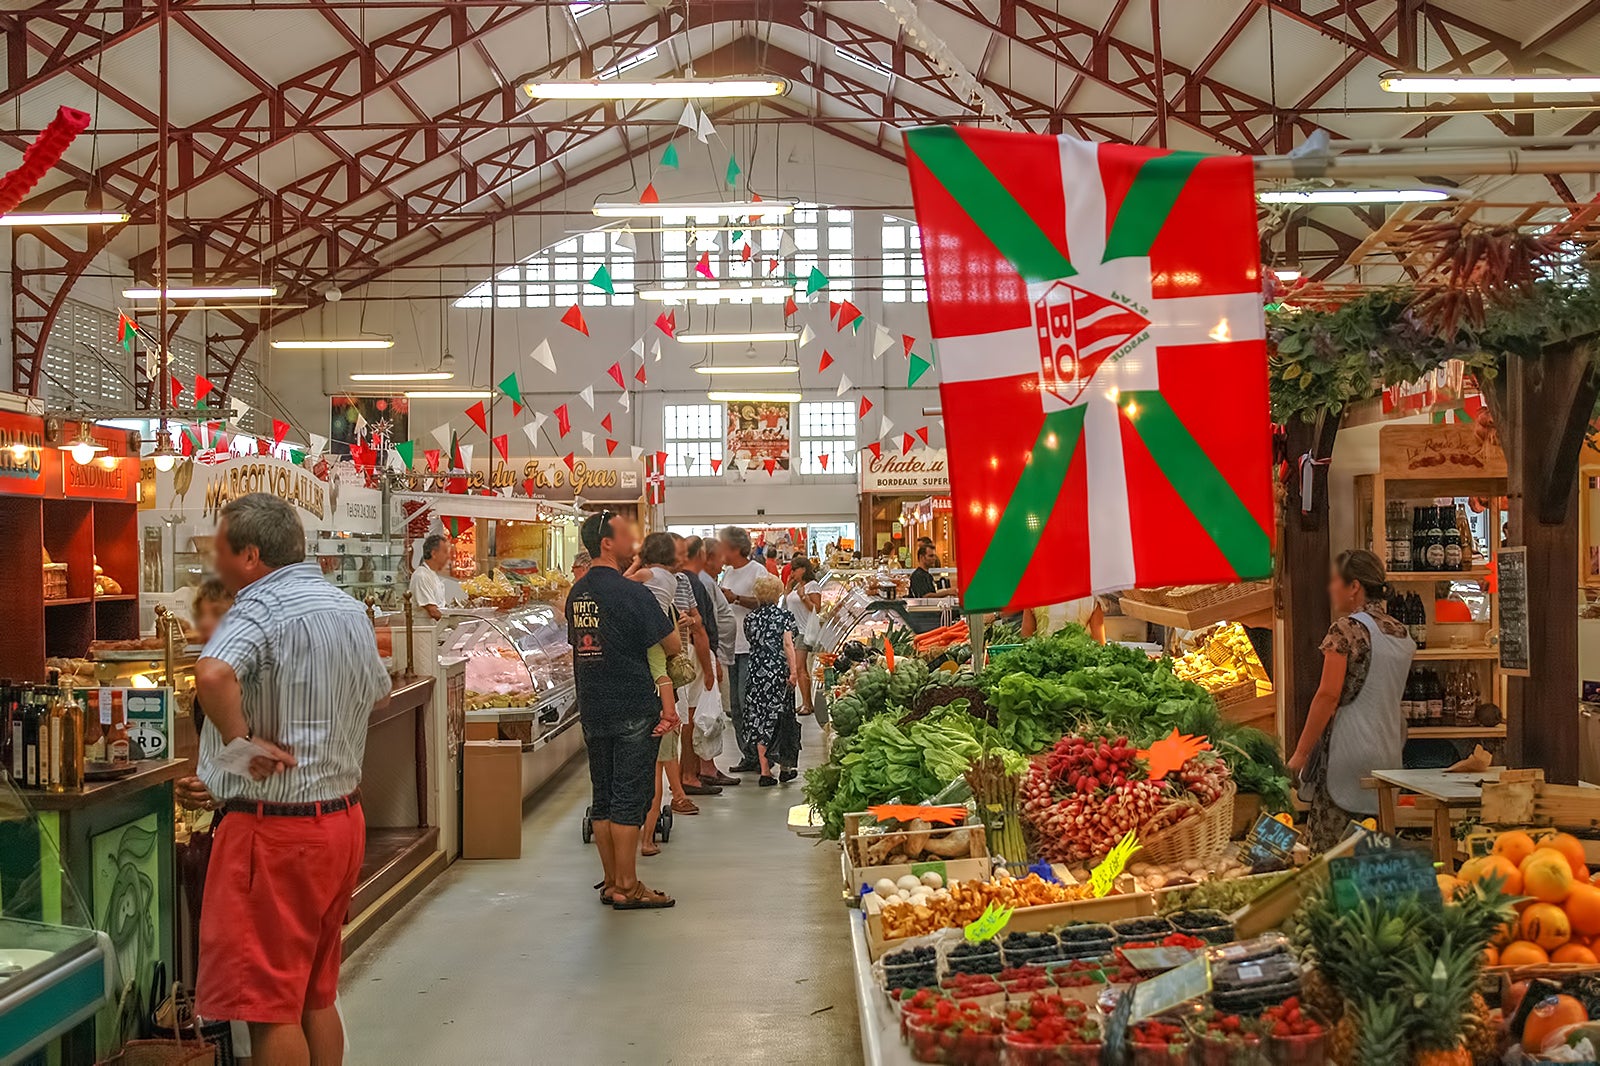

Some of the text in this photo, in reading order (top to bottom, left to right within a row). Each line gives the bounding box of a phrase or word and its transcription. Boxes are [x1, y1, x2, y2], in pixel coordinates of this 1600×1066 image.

[1049, 303, 1076, 384] BO
[491, 461, 516, 489] du
[524, 461, 564, 489] Foe
[568, 461, 618, 495] Gras
[877, 477, 950, 486] BORDEAUX SUPER
